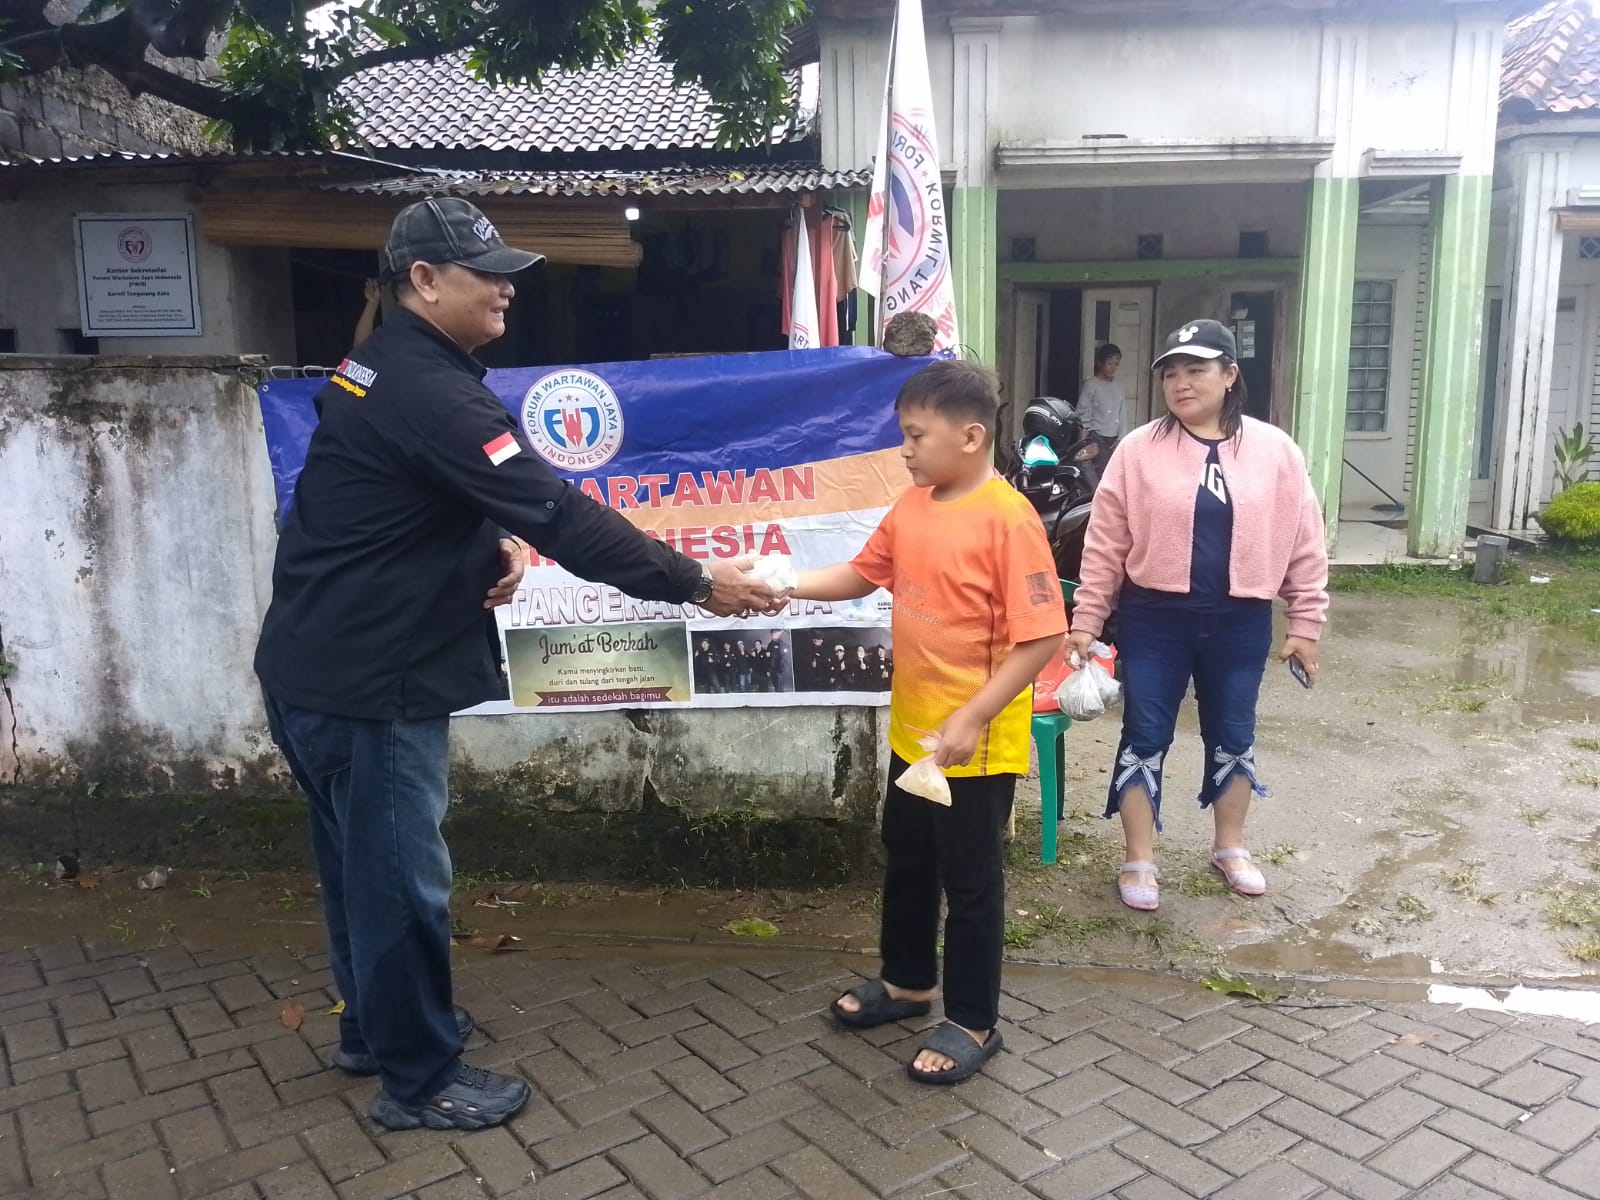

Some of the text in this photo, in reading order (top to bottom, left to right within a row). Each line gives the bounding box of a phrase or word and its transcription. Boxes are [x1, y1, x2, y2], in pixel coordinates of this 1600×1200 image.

[526, 375, 618, 435] FORUM WARTAWAN JAYA
[542, 442, 614, 465] INDONESIA
[567, 466, 816, 511] ARTAWAN
[511, 584, 717, 627] TANGERA
[539, 631, 658, 665] Jum'at Berkah
[557, 668, 578, 676] Kamu
[580, 666, 627, 676] menyingkirkan
[565, 678, 578, 686] dan
[579, 678, 600, 686] tulang
[615, 676, 639, 685] tengah
[639, 675, 655, 684] jalan
[547, 691, 661, 704] itu adalah sedekah bagimu
